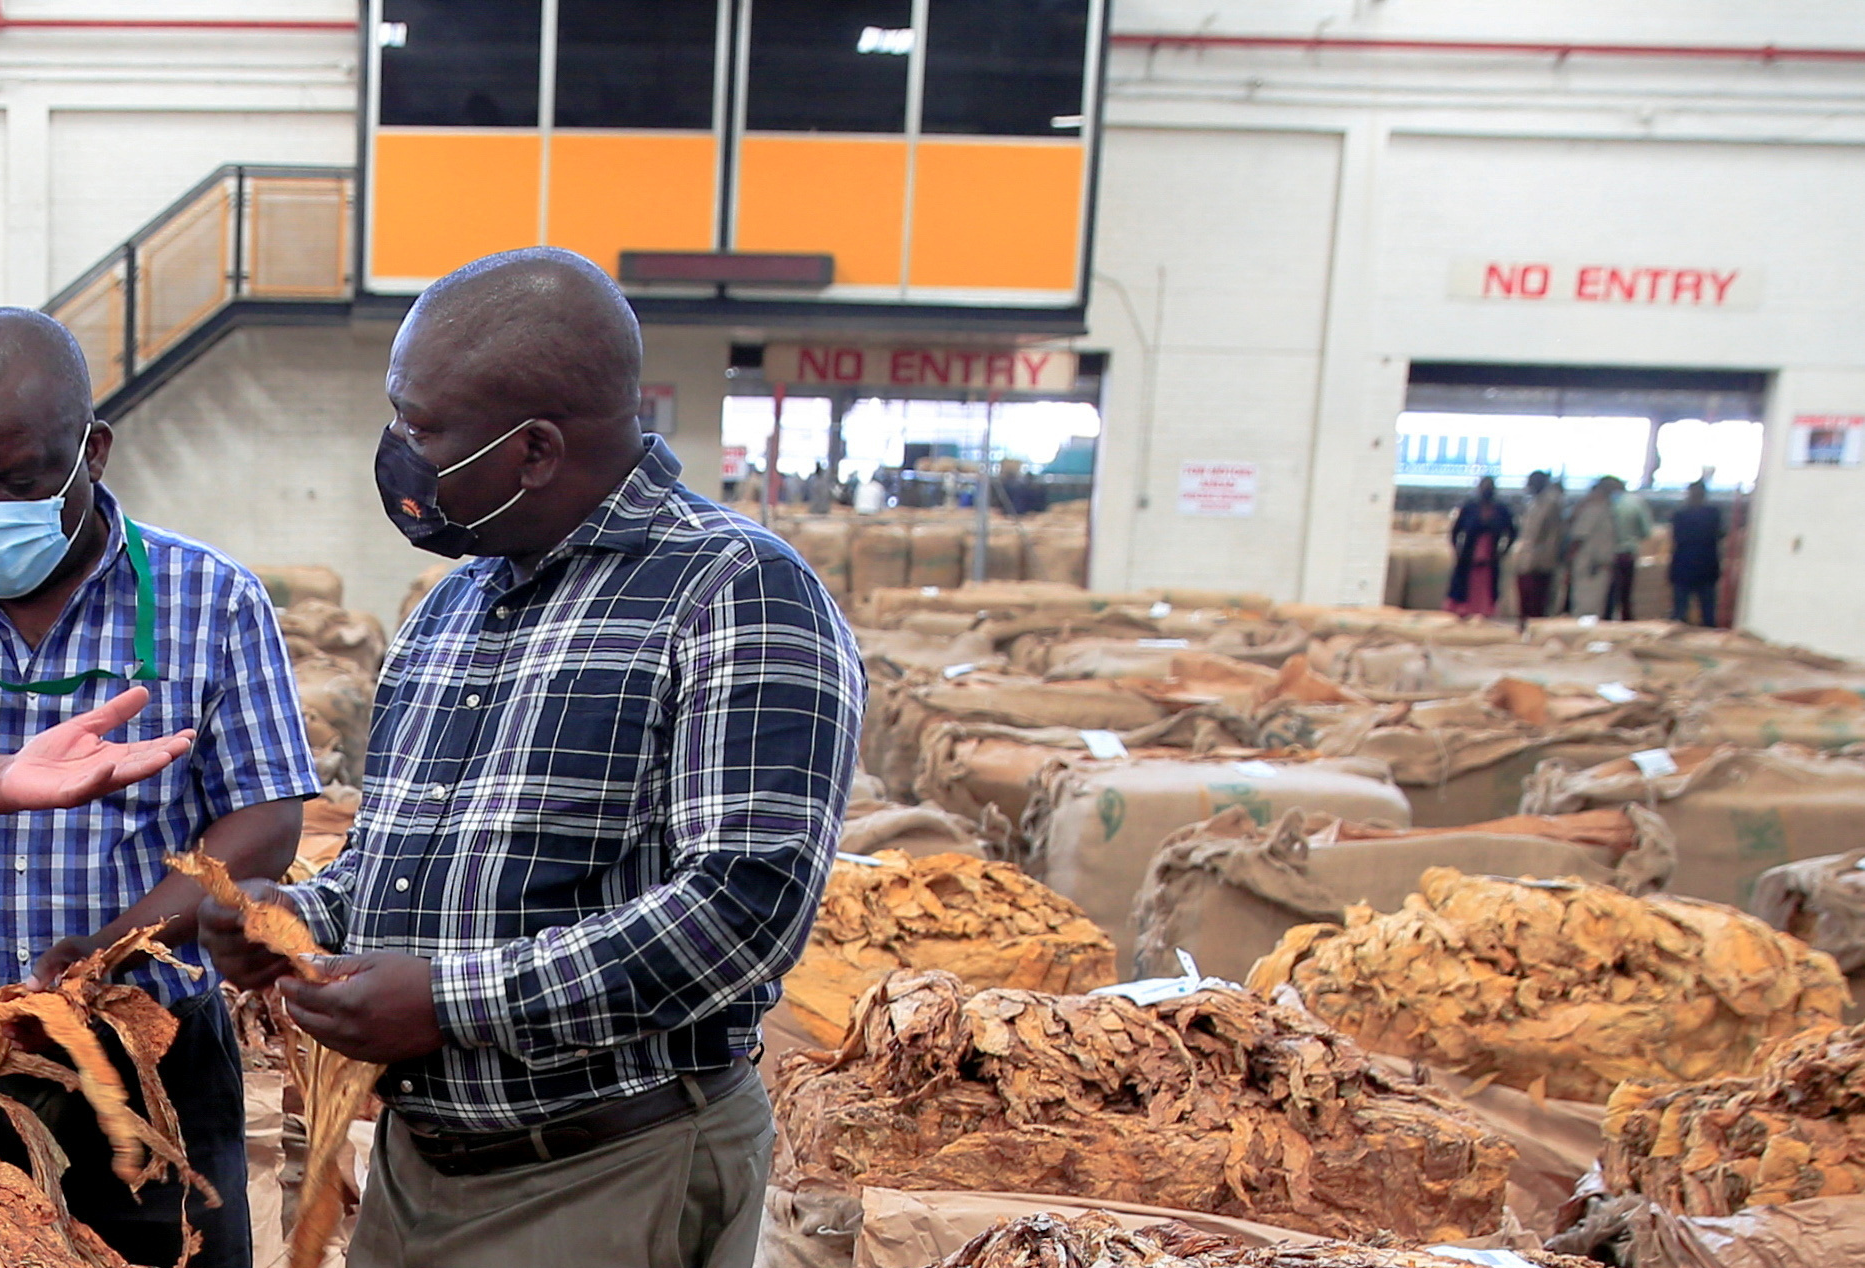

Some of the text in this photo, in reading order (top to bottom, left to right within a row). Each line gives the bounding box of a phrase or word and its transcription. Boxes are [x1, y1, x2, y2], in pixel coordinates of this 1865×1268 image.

[1484, 263, 1739, 304] NO ENTRY
[798, 347, 1051, 387] NO ENTRY
